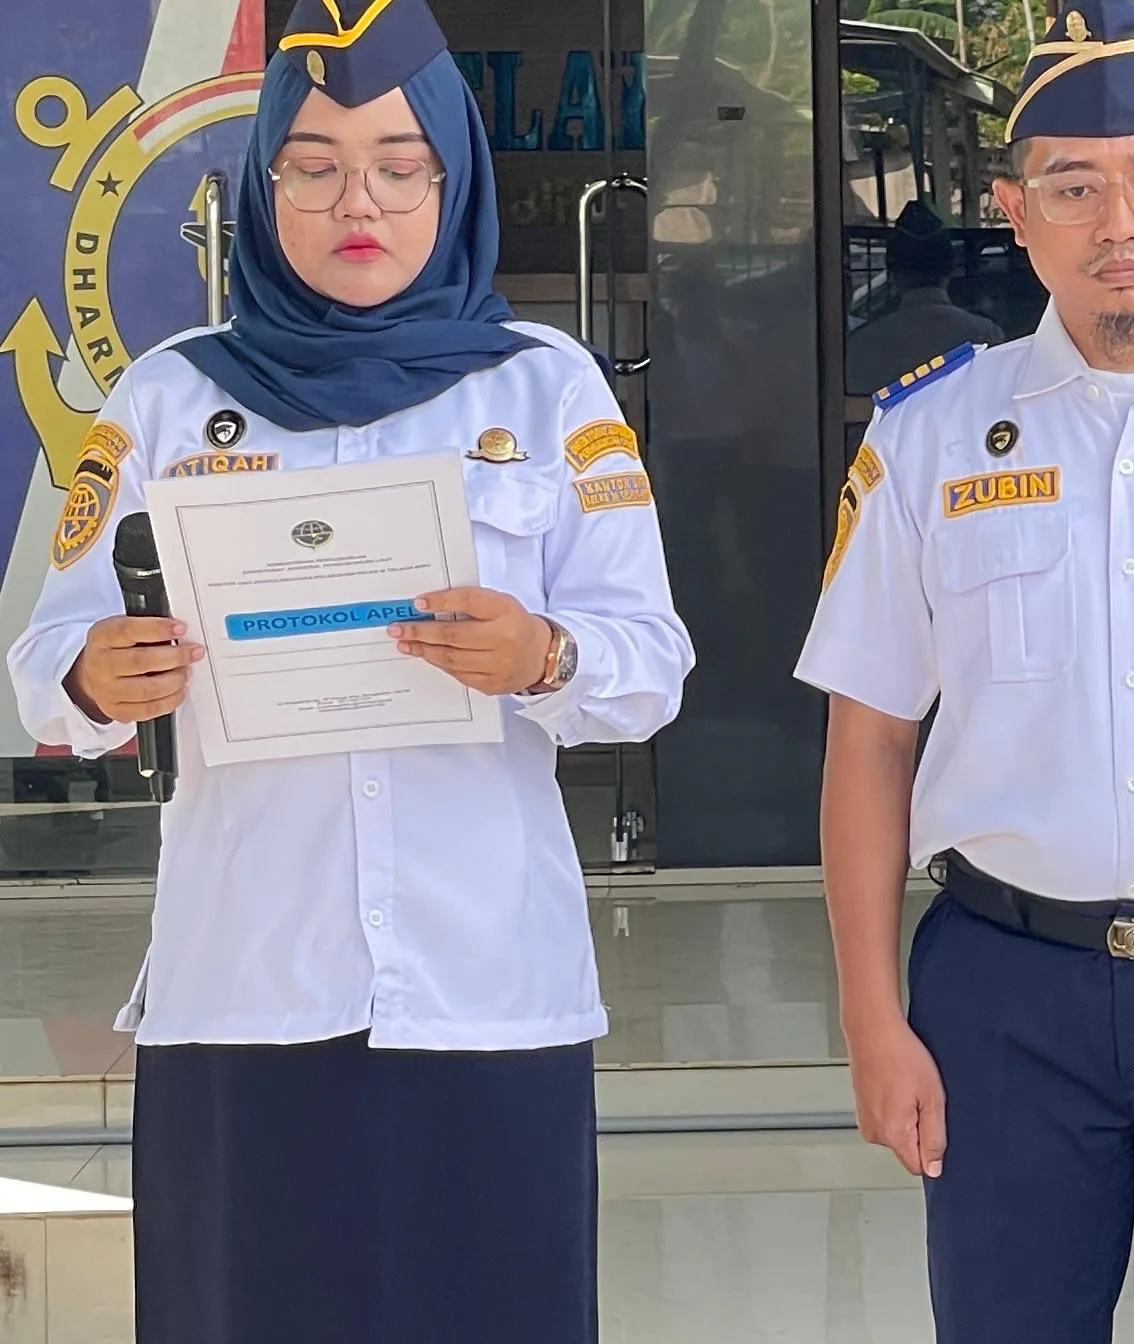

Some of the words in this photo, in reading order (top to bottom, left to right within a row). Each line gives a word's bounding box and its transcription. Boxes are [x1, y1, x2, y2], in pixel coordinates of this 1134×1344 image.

[175, 455, 268, 478] ATIQAH
[953, 472, 1052, 510] ZUBIN
[242, 610, 361, 632] PROTOKOL
[366, 605, 419, 622] APEL
